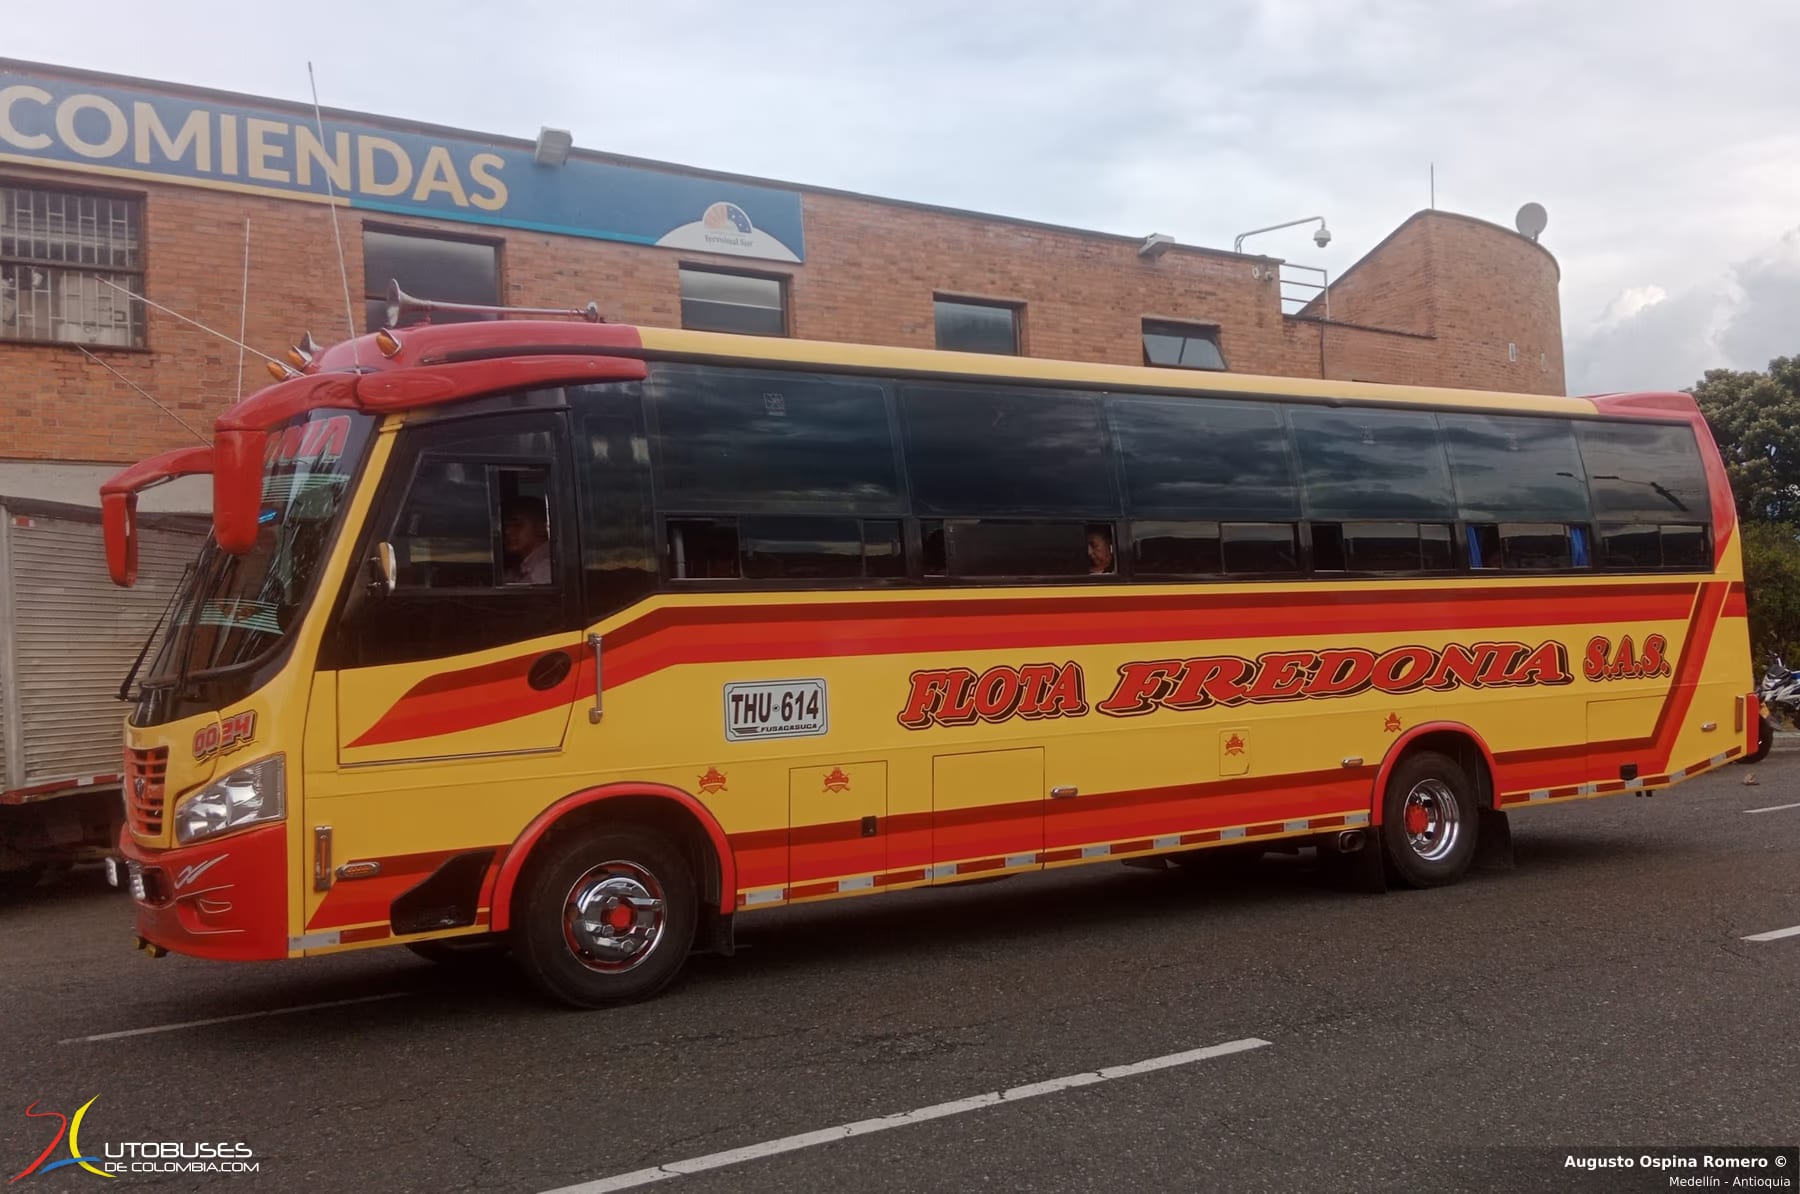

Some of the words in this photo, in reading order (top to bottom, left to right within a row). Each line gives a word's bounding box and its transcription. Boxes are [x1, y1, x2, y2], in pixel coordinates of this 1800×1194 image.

[0, 85, 509, 210] COMIENDAS
[898, 660, 1089, 730] FLOTA
[1095, 640, 1574, 718] FREDONIA
[1583, 633, 1672, 683] S.A.S.
[192, 709, 258, 761] 0024
